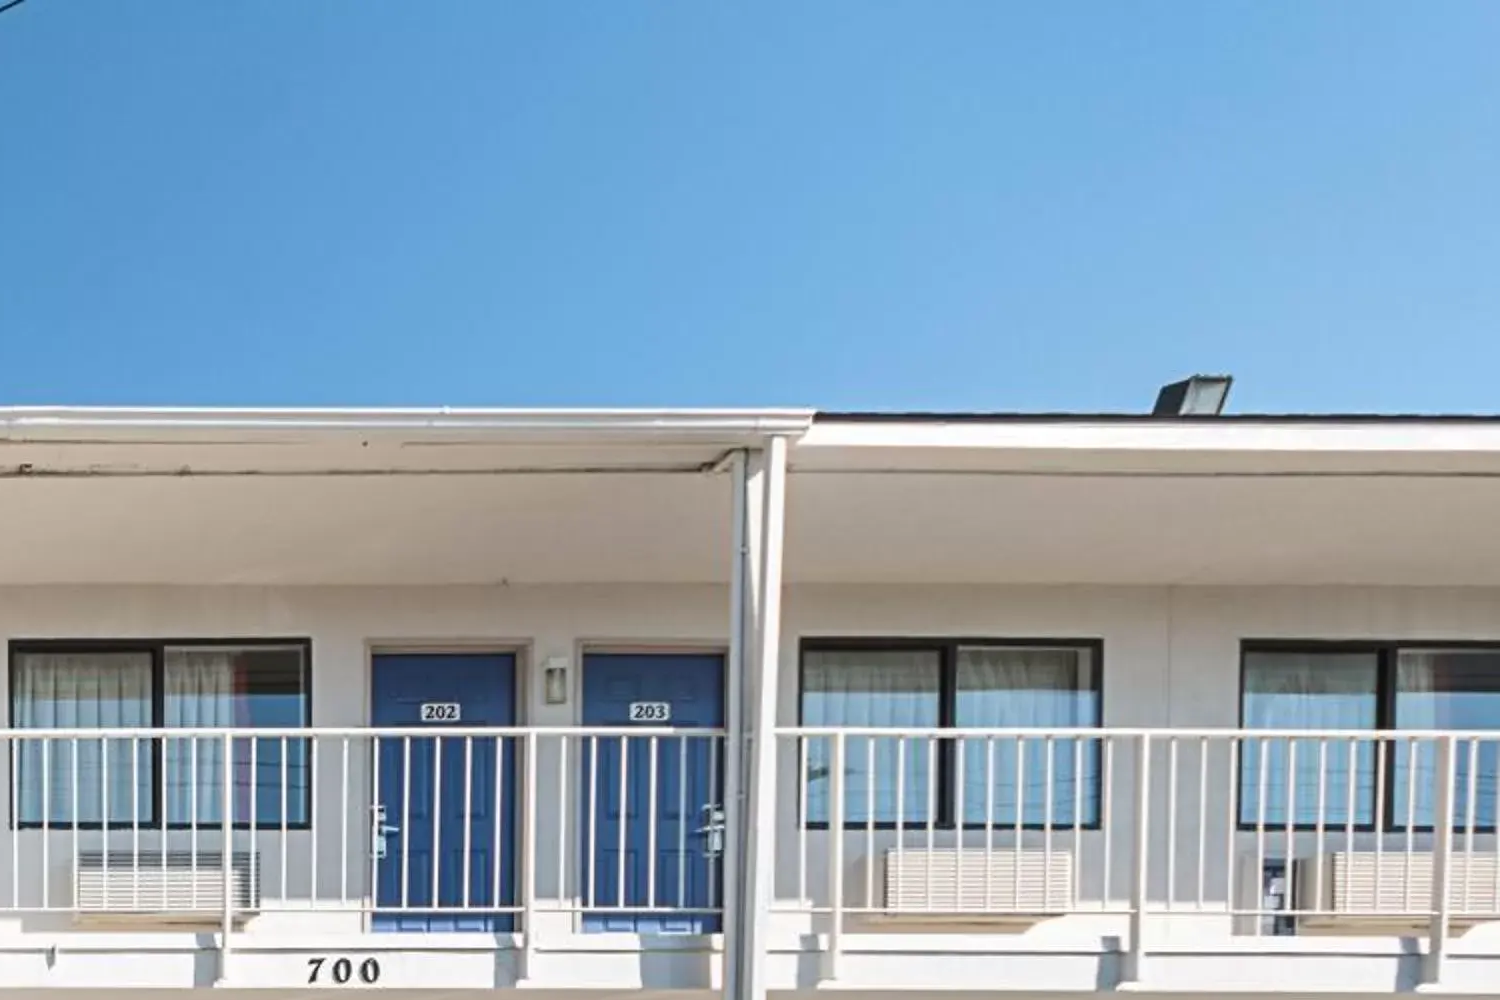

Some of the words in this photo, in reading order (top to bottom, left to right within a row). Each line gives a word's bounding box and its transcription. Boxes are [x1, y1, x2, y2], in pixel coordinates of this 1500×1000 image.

[425, 705, 457, 719] 202
[634, 705, 666, 719] 203
[307, 957, 381, 984] 700
